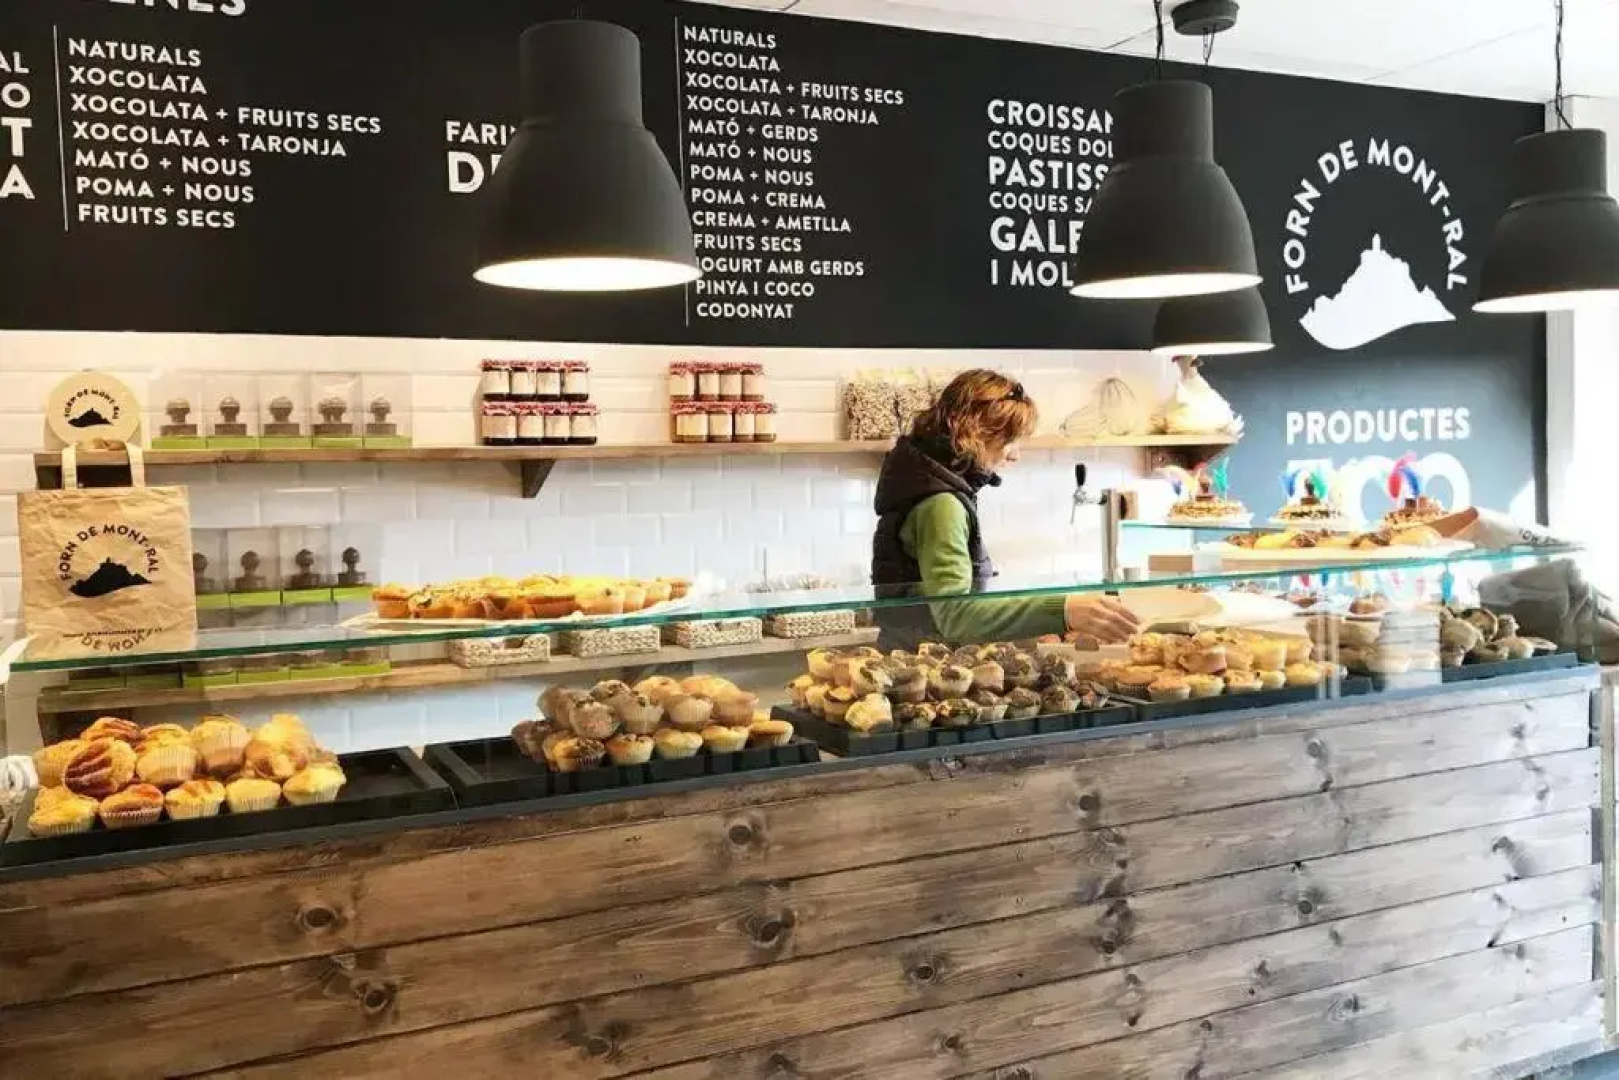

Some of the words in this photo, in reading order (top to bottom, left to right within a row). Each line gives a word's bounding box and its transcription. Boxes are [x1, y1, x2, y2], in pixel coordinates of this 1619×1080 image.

[684, 25, 777, 50] NATURALS
[68, 37, 202, 67] NATURALS
[684, 48, 780, 72] XOCOLATA
[69, 65, 207, 95] XOCOLATA
[685, 71, 781, 95] XOCOLATA
[786, 83, 795, 93] +
[801, 81, 860, 102] FRUITS
[864, 87, 904, 105] SECS
[70, 92, 208, 121] XOCOLATA
[216, 108, 229, 120] +
[238, 106, 319, 129] FRUITS
[326, 113, 382, 134] SECS
[686, 94, 782, 118] XOCOLATA
[787, 106, 796, 115] +
[801, 104, 879, 125] TARONJA
[72, 120, 210, 148] XOCOLATA
[217, 135, 230, 146] +
[237, 132, 347, 157] TARONJA
[688, 116, 740, 137] MATÓ
[746, 126, 755, 135] +
[761, 124, 819, 143] GERDS
[987, 129, 1071, 156] COQUES
[75, 147, 150, 170] MATÓ
[159, 157, 172, 169] +
[181, 156, 252, 177] NOUS
[689, 139, 741, 159] MATÓ
[747, 147, 757, 158] +
[763, 146, 812, 164] NOUS
[690, 164, 744, 183] POMA
[749, 170, 758, 180] +
[764, 168, 814, 186] NOUS
[76, 176, 154, 198] POMA
[162, 184, 175, 196] +
[184, 182, 254, 203] NOUS
[691, 187, 746, 205] POMA
[750, 193, 760, 203] +
[765, 191, 826, 210] CREMA
[989, 191, 1069, 215] COQUES
[78, 203, 168, 226] FRUITS
[176, 208, 235, 229] SECS
[692, 210, 756, 229] CREMA
[761, 217, 769, 226] +
[775, 215, 852, 233] AMETLLA
[1283, 179, 1321, 294] FORN
[1317, 139, 1359, 184] DE
[693, 233, 755, 251] FRUITS
[760, 236, 802, 253] SECS
[766, 259, 804, 275] AMB
[809, 260, 864, 276] GERDS
[990, 258, 999, 285] I
[695, 279, 749, 295] PINYA
[753, 281, 758, 296] I
[764, 281, 815, 297] COCO
[696, 302, 794, 319] CODONYAT
[1286, 407, 1471, 445] PRODUCTES
[59, 541, 78, 581] FORN
[76, 526, 98, 541] DE
